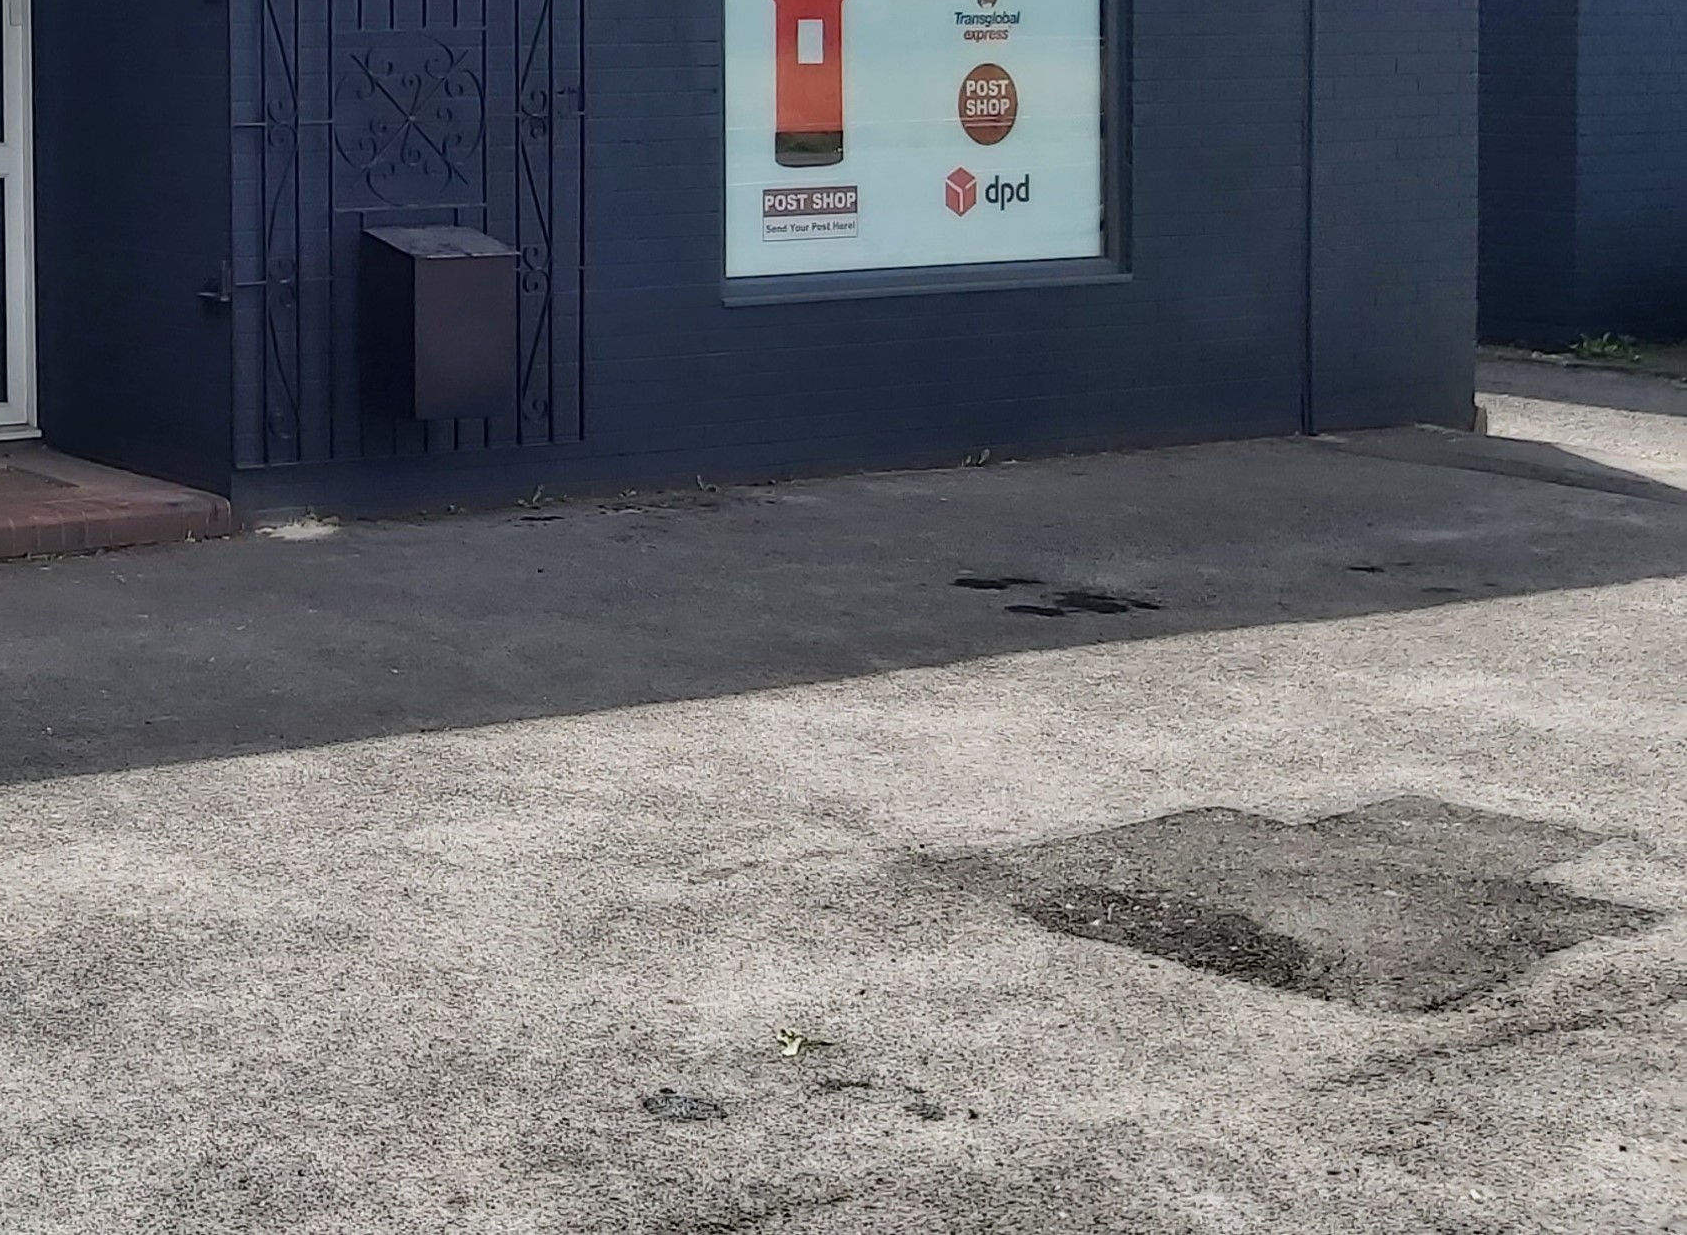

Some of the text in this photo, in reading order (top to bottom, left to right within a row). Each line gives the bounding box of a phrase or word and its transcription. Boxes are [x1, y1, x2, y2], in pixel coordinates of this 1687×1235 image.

[954, 11, 1021, 27] Transglobal
[963, 29, 1009, 41] express
[966, 79, 1009, 97] POST
[965, 98, 1011, 116] SHOP
[984, 173, 1030, 211] dpd
[764, 191, 856, 212] POST SHOP
[789, 223, 809, 232] Your
